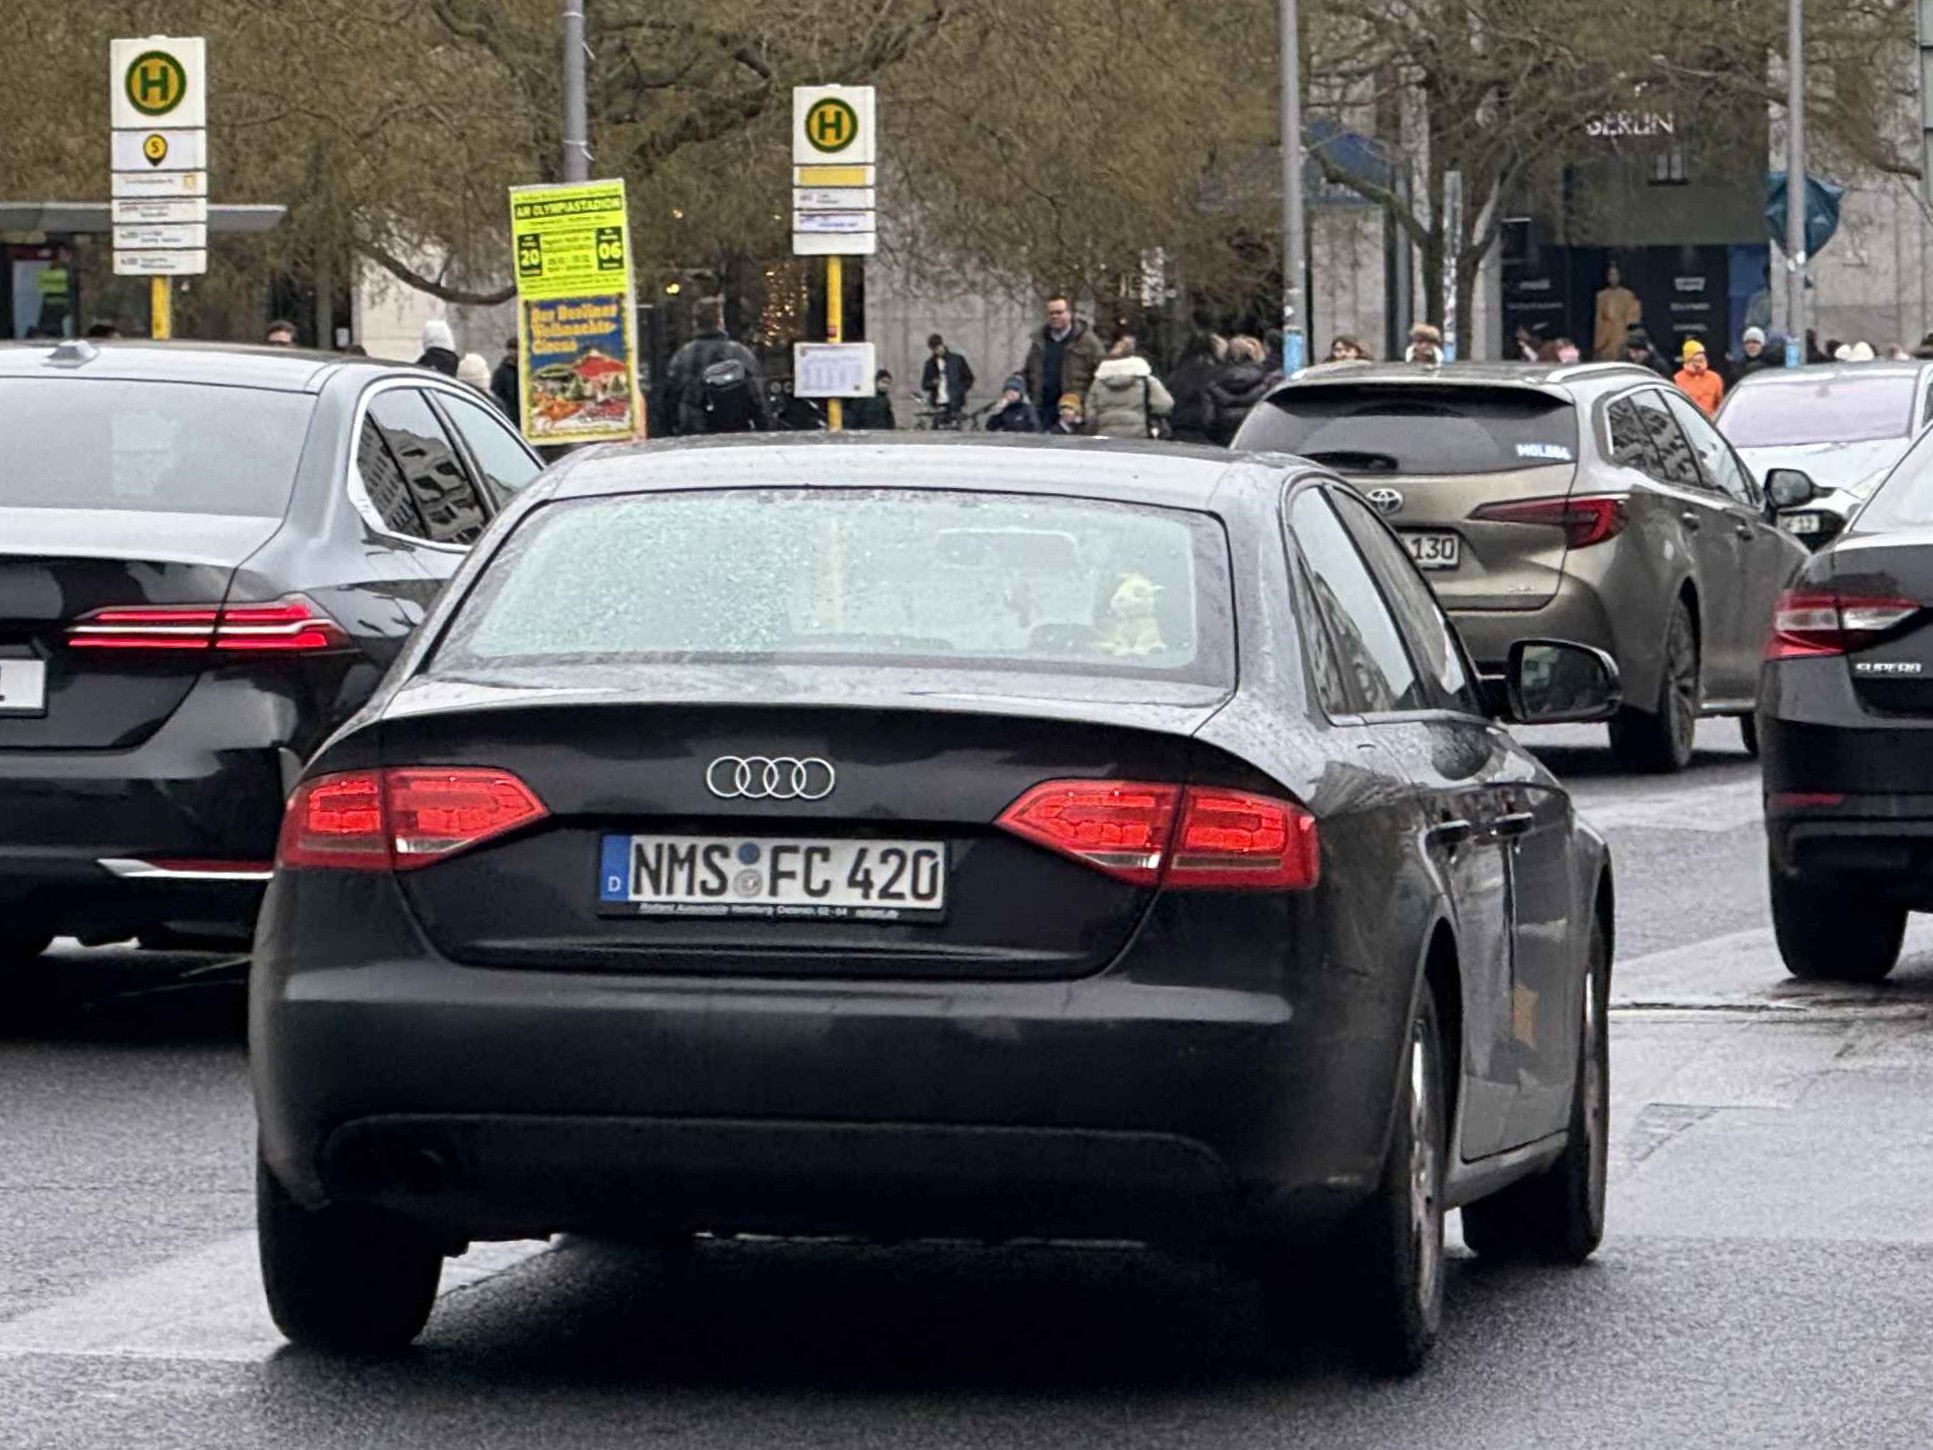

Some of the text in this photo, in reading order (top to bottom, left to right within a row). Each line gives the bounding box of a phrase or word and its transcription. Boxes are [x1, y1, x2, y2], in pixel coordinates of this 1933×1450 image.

[140, 66, 168, 101] H
[818, 111, 842, 139] H
[520, 249, 540, 267] 20
[599, 242, 622, 260] 06
[1411, 537, 1455, 560] 130
[632, 843, 940, 901] NMS FC 420
[607, 876, 621, 892] D
